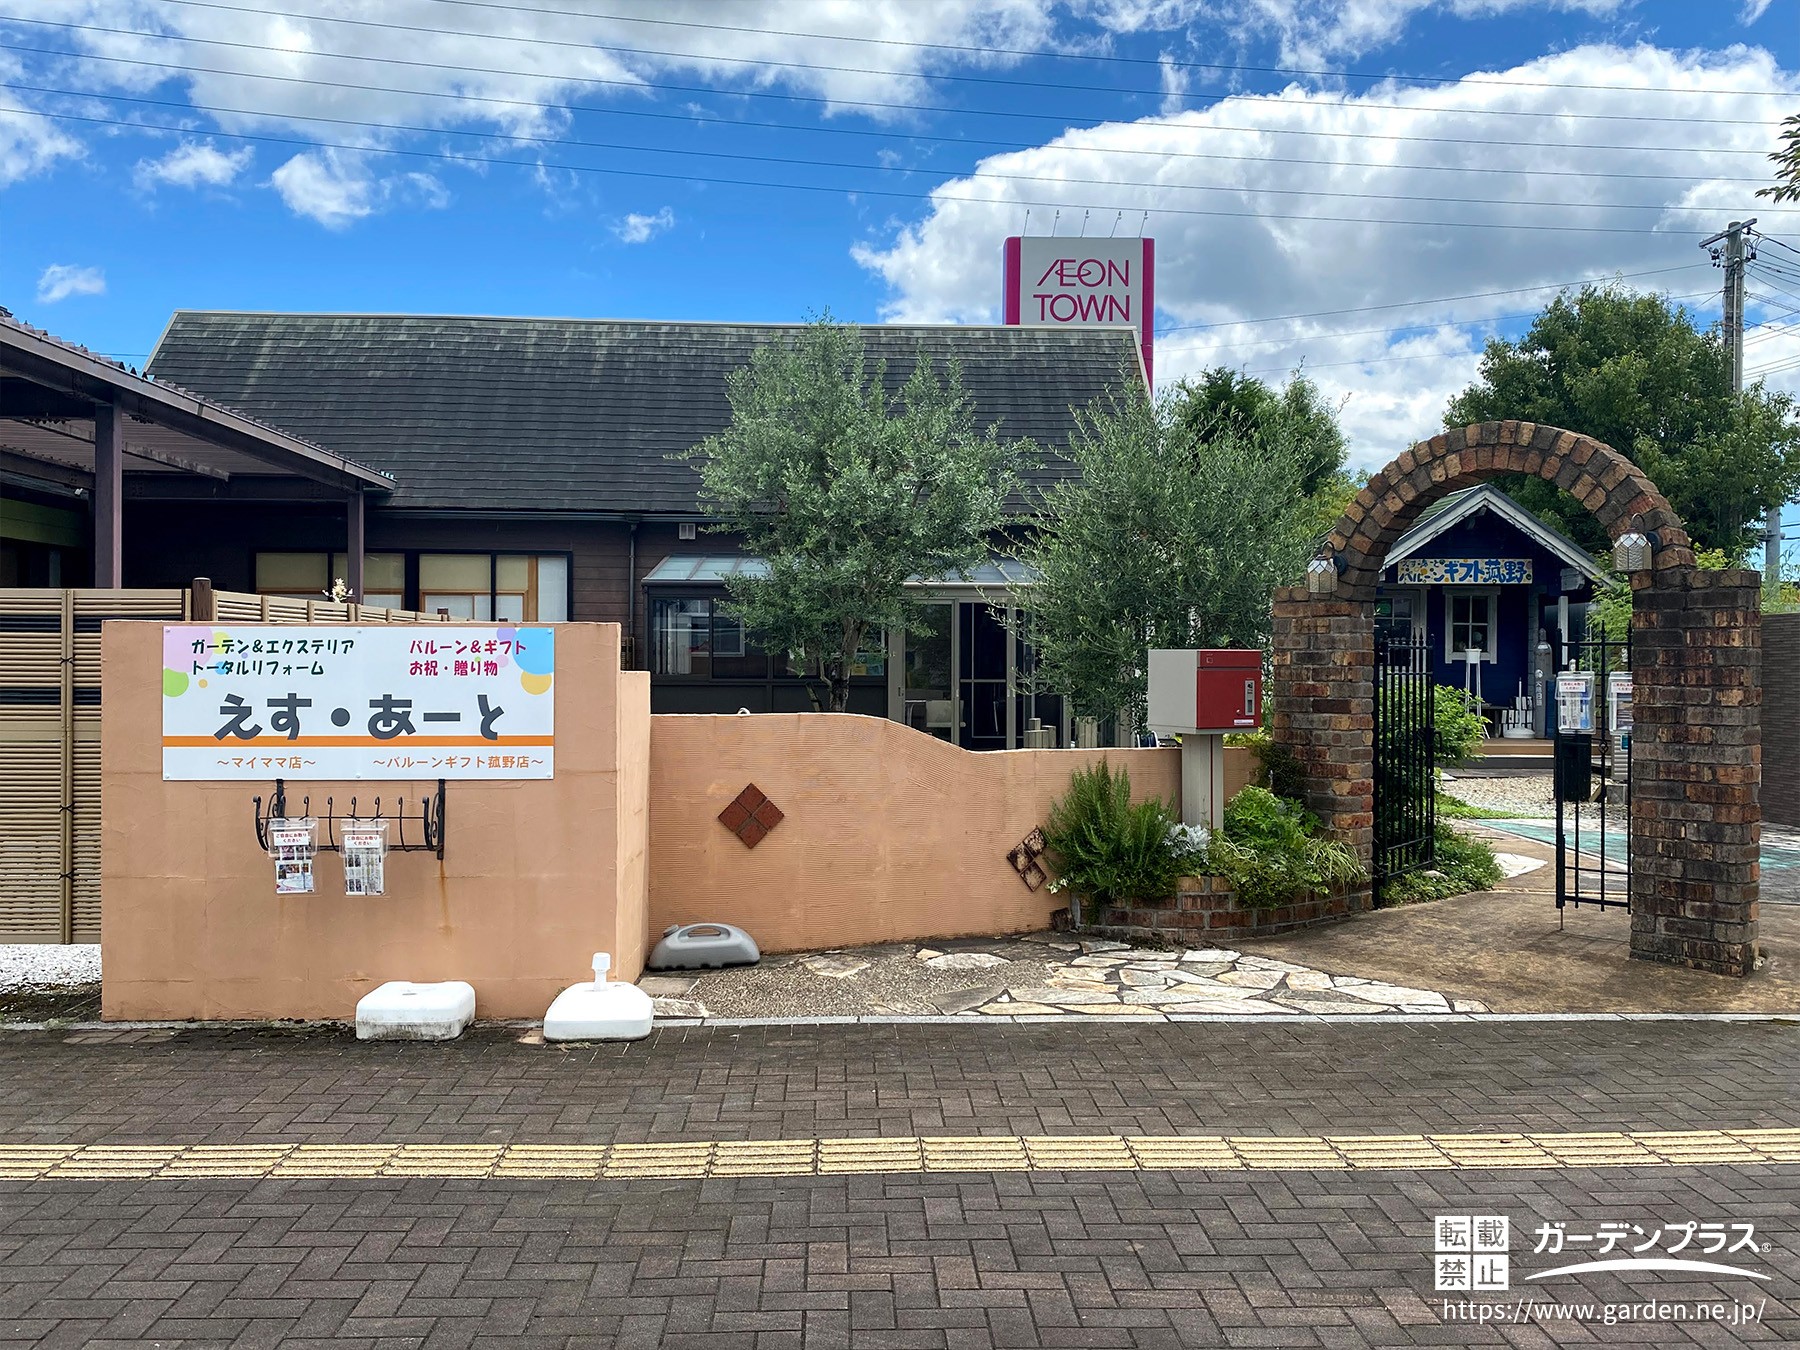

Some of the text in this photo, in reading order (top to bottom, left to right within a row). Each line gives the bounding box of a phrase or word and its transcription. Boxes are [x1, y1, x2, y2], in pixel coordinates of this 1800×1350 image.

[1033, 293, 1130, 322] TOWN
[192, 639, 355, 655] ガーデン&エクステリア
[409, 639, 527, 655] バルーン&ギフト
[192, 660, 325, 676] トータルリフォーム
[409, 660, 499, 677] お祝・贈り物
[213, 692, 505, 741] えす・あーと
